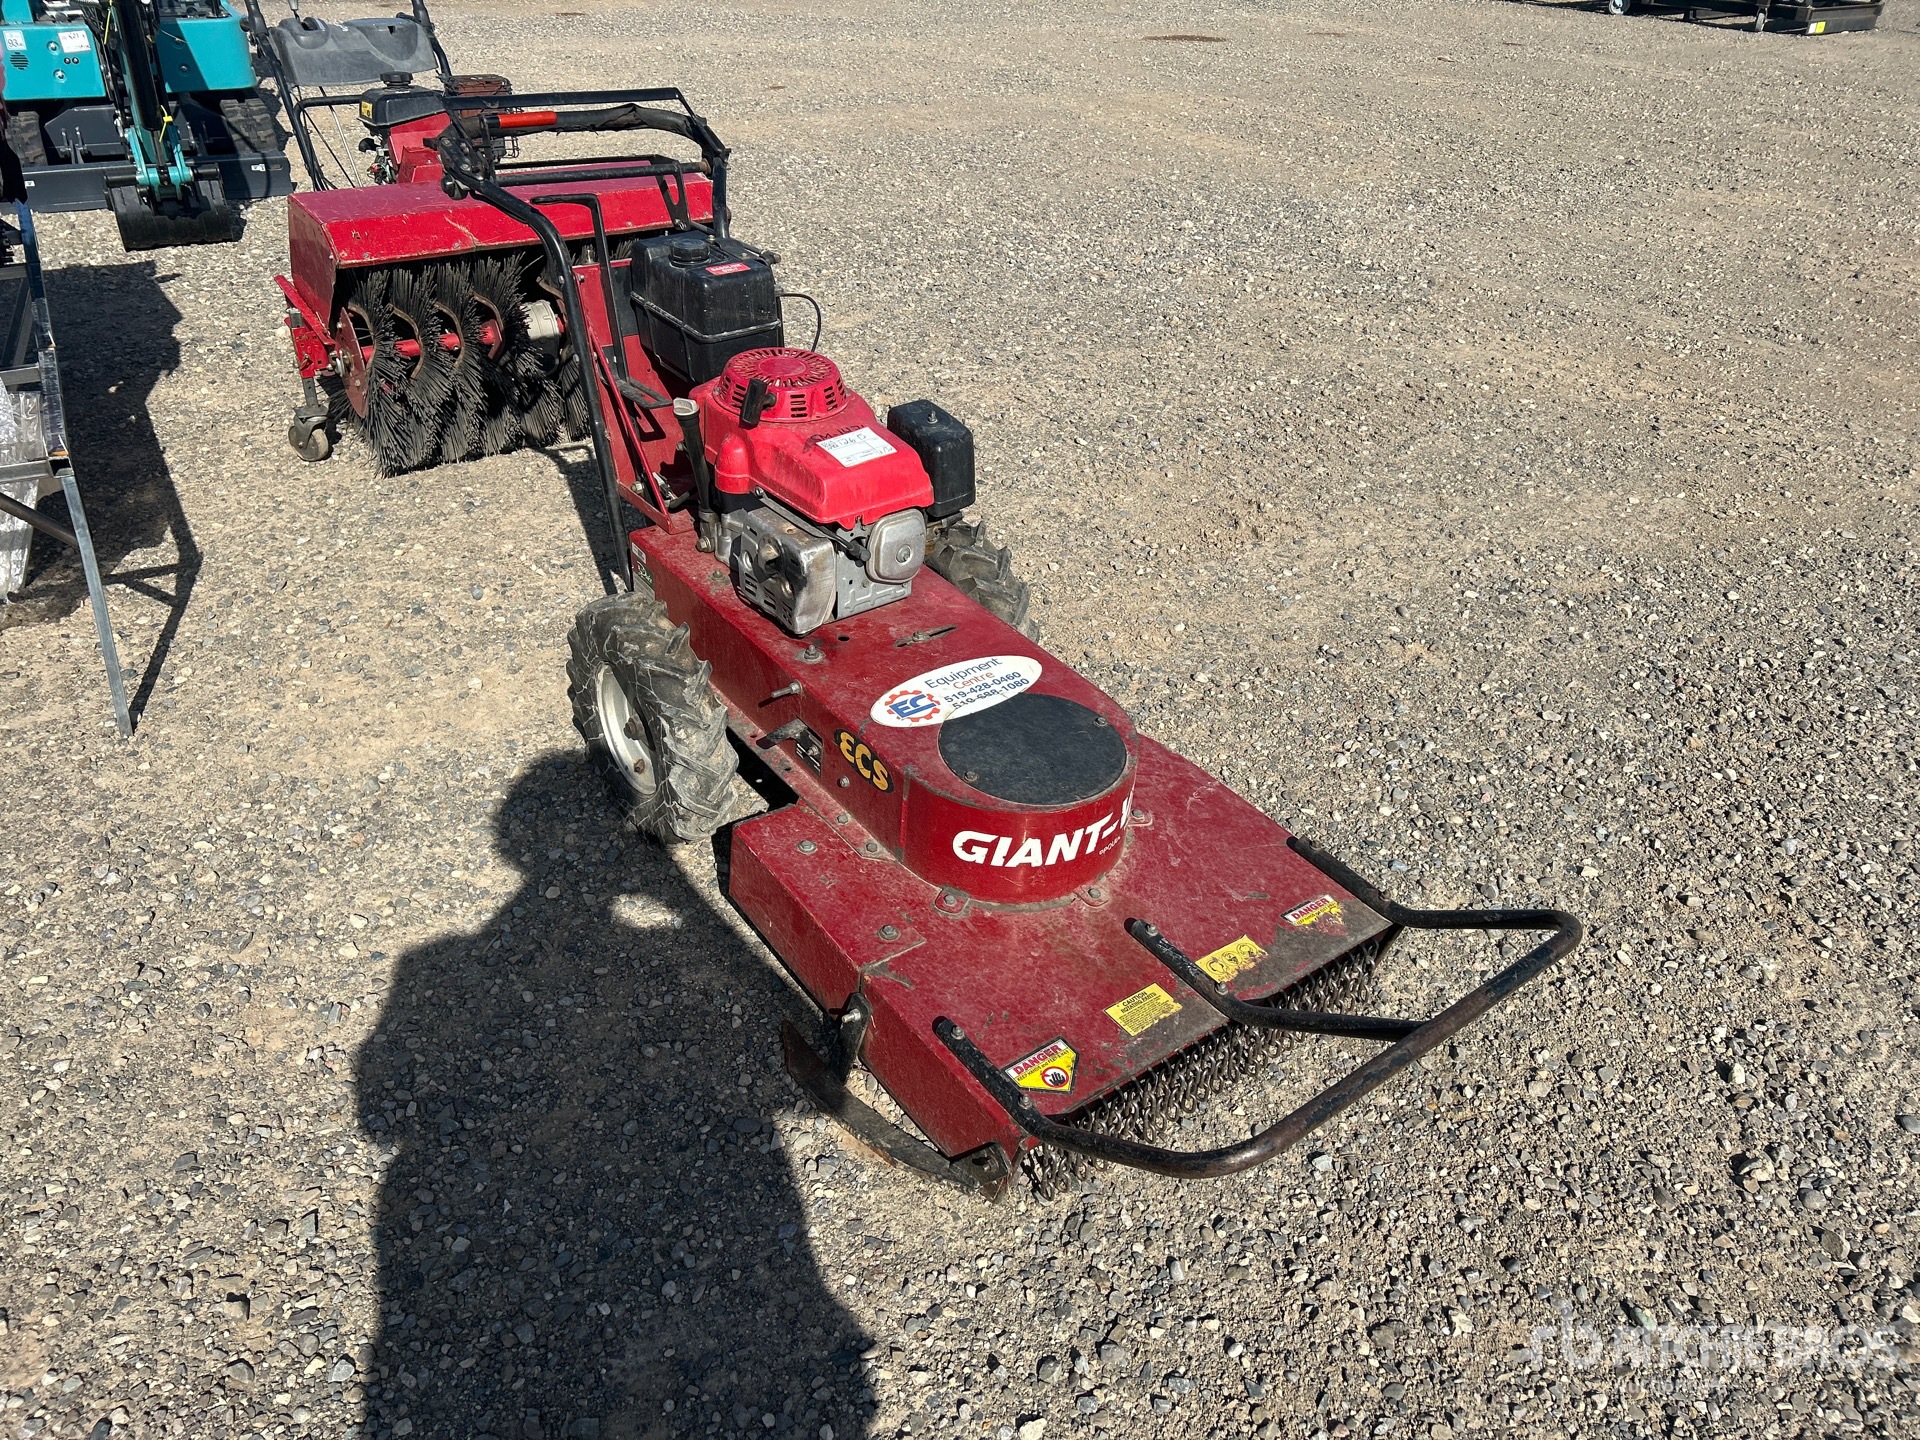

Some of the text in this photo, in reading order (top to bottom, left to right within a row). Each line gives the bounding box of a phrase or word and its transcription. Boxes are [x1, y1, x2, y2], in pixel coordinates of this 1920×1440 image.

[924, 657, 1003, 689] Equipment
[952, 670, 996, 690] Centre
[943, 671, 1022, 703] 519-428-0460
[889, 693, 937, 719] EC
[840, 731, 889, 791] ECS
[1291, 897, 1330, 919] DANGER
[1121, 992, 1157, 1014] ROTATING PARTS
[1122, 990, 1148, 1007] CAUTION
[1013, 1044, 1061, 1075] DANGER
